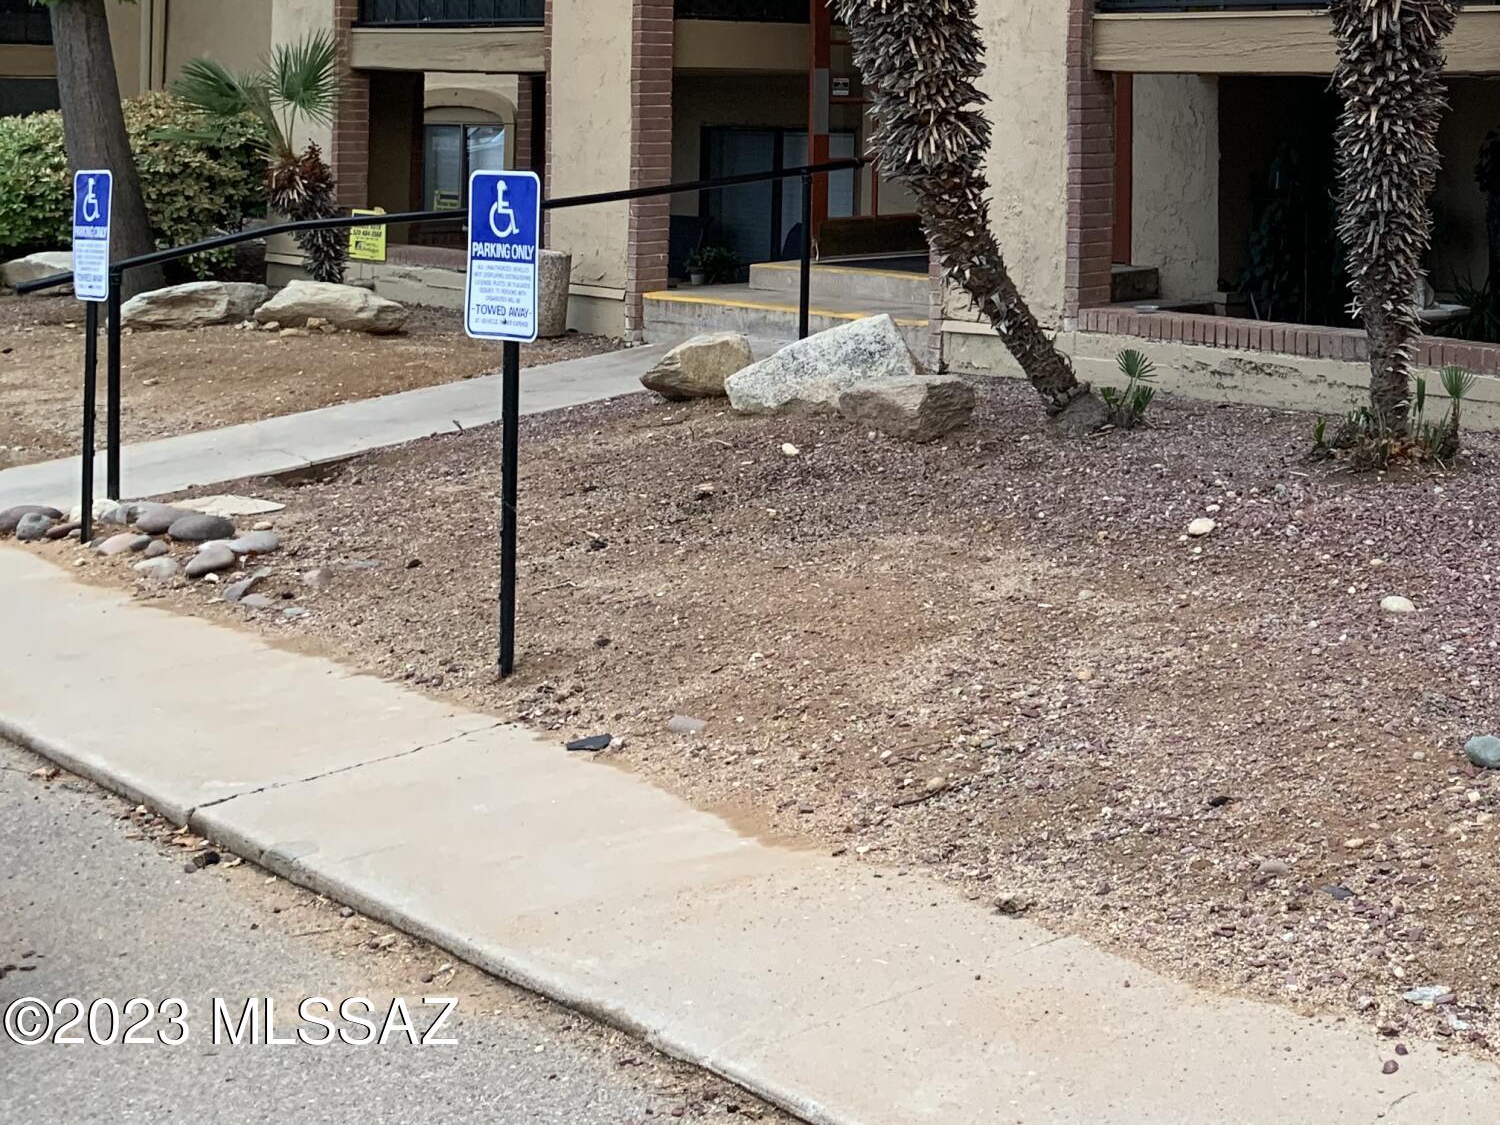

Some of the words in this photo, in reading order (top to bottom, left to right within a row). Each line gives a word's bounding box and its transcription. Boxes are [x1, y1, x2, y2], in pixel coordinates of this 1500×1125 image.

[472, 241, 511, 259] PARKING
[511, 244, 535, 261] ONLY
[475, 303, 507, 316] TOWED
[508, 306, 529, 318] AWAY
